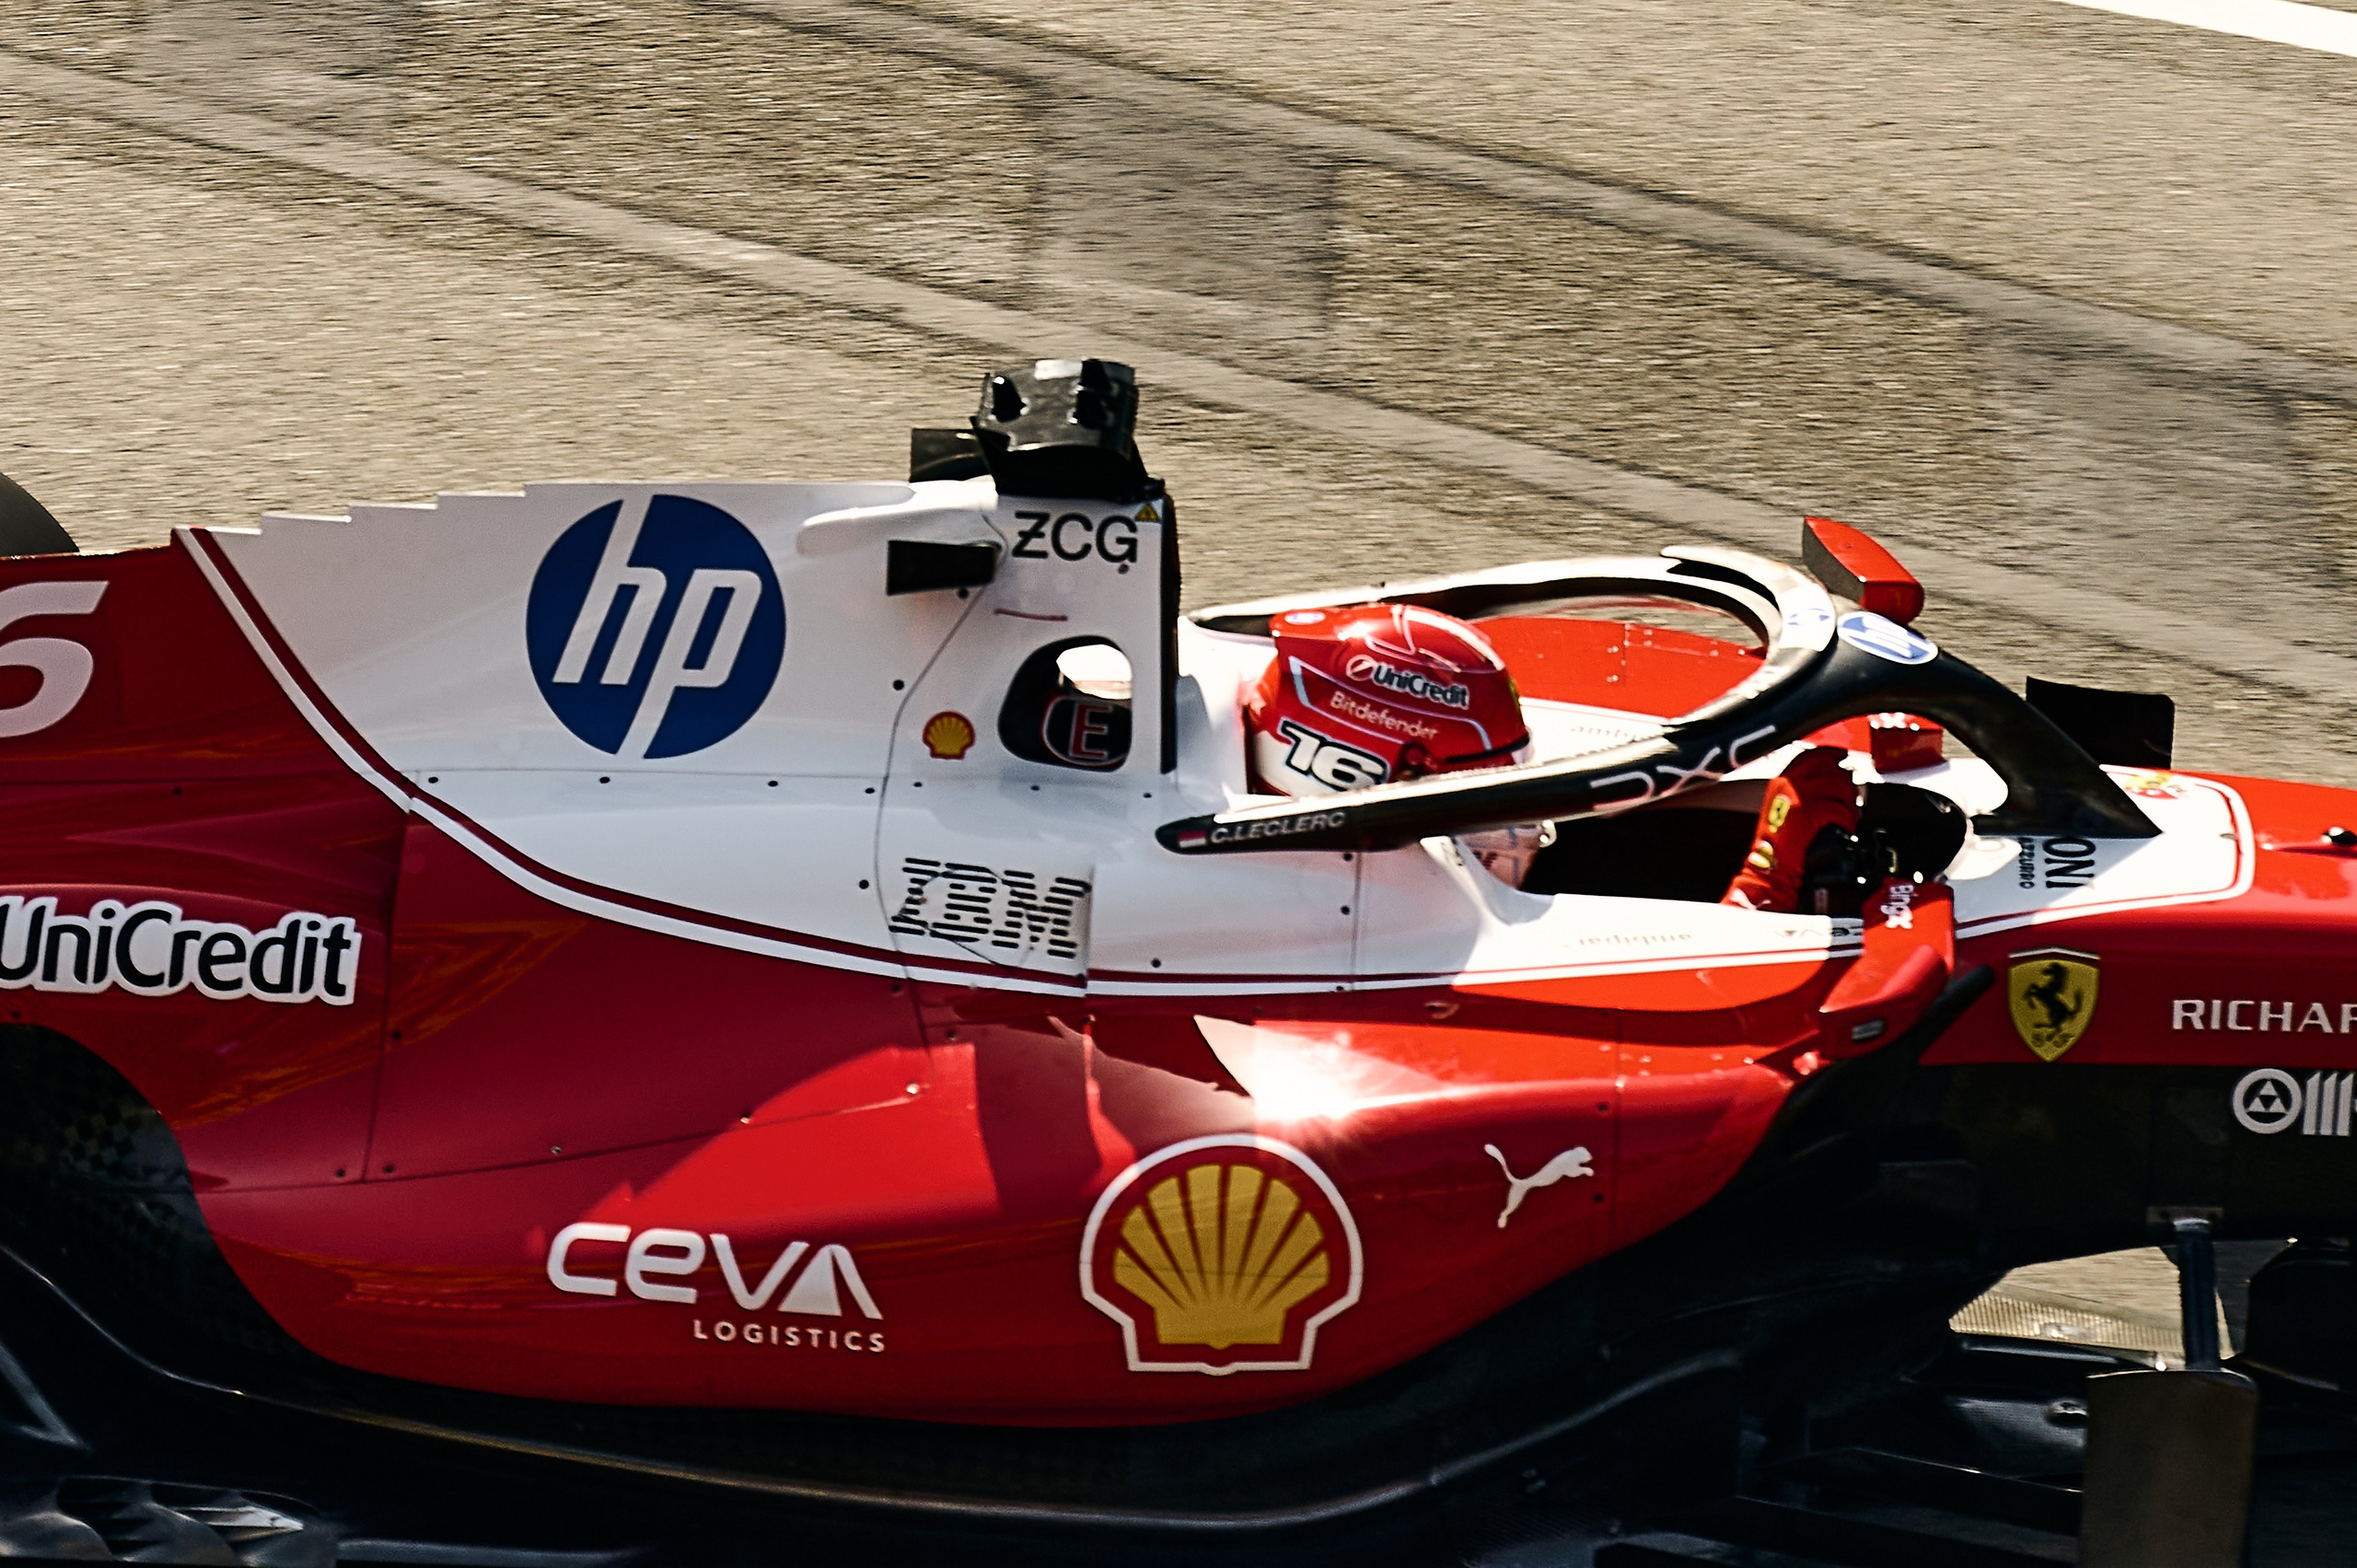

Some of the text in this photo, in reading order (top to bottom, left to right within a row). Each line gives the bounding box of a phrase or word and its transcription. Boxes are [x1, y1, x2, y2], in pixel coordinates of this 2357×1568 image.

[552, 494, 763, 760] hp
[1330, 691, 1437, 739] Bitdefender
[1374, 664, 1469, 708] UniCredit
[1280, 718, 1391, 792] 16
[1590, 724, 1776, 813] DXC
[1211, 811, 1345, 844] C.LECLERC
[2043, 837, 2096, 889] ONI
[888, 857, 1092, 959] IBM
[0, 901, 352, 997] UniCredit
[693, 1318, 886, 1353] LOGISTICS
